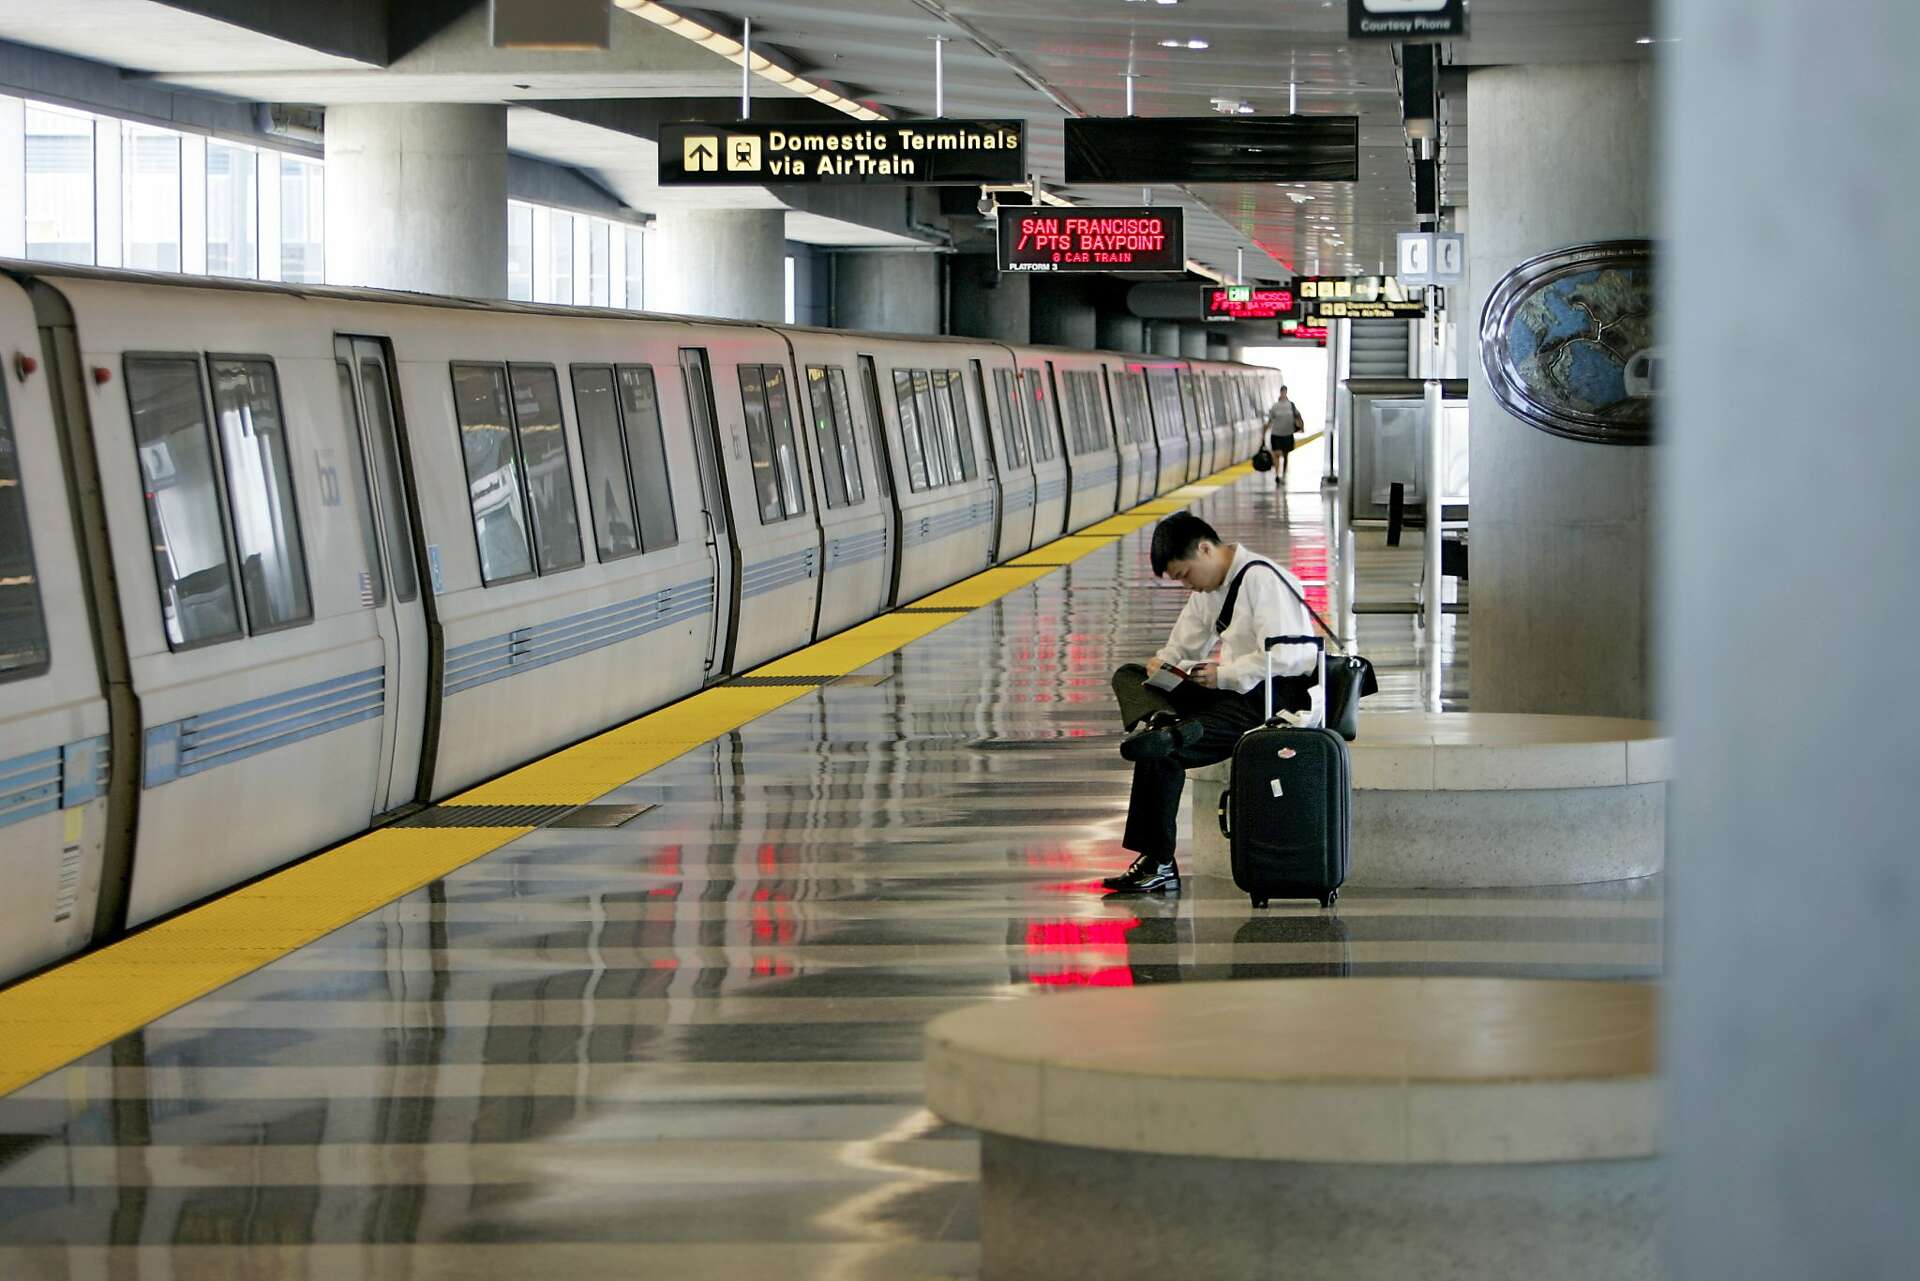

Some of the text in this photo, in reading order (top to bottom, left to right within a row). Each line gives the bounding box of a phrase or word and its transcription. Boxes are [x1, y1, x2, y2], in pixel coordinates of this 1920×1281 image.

[1361, 18, 1450, 32] Courtesy Phone
[769, 129, 1018, 150] Domestic Terminals
[769, 155, 915, 175] via AirTrain
[1022, 219, 1161, 234] SAN FRANCISCO
[1018, 235, 1165, 250] / PTS BAYPOINT
[1065, 252, 1090, 262] CAR
[1095, 252, 1131, 262] TRAIN
[1009, 263, 1058, 271] PLATFORM 3
